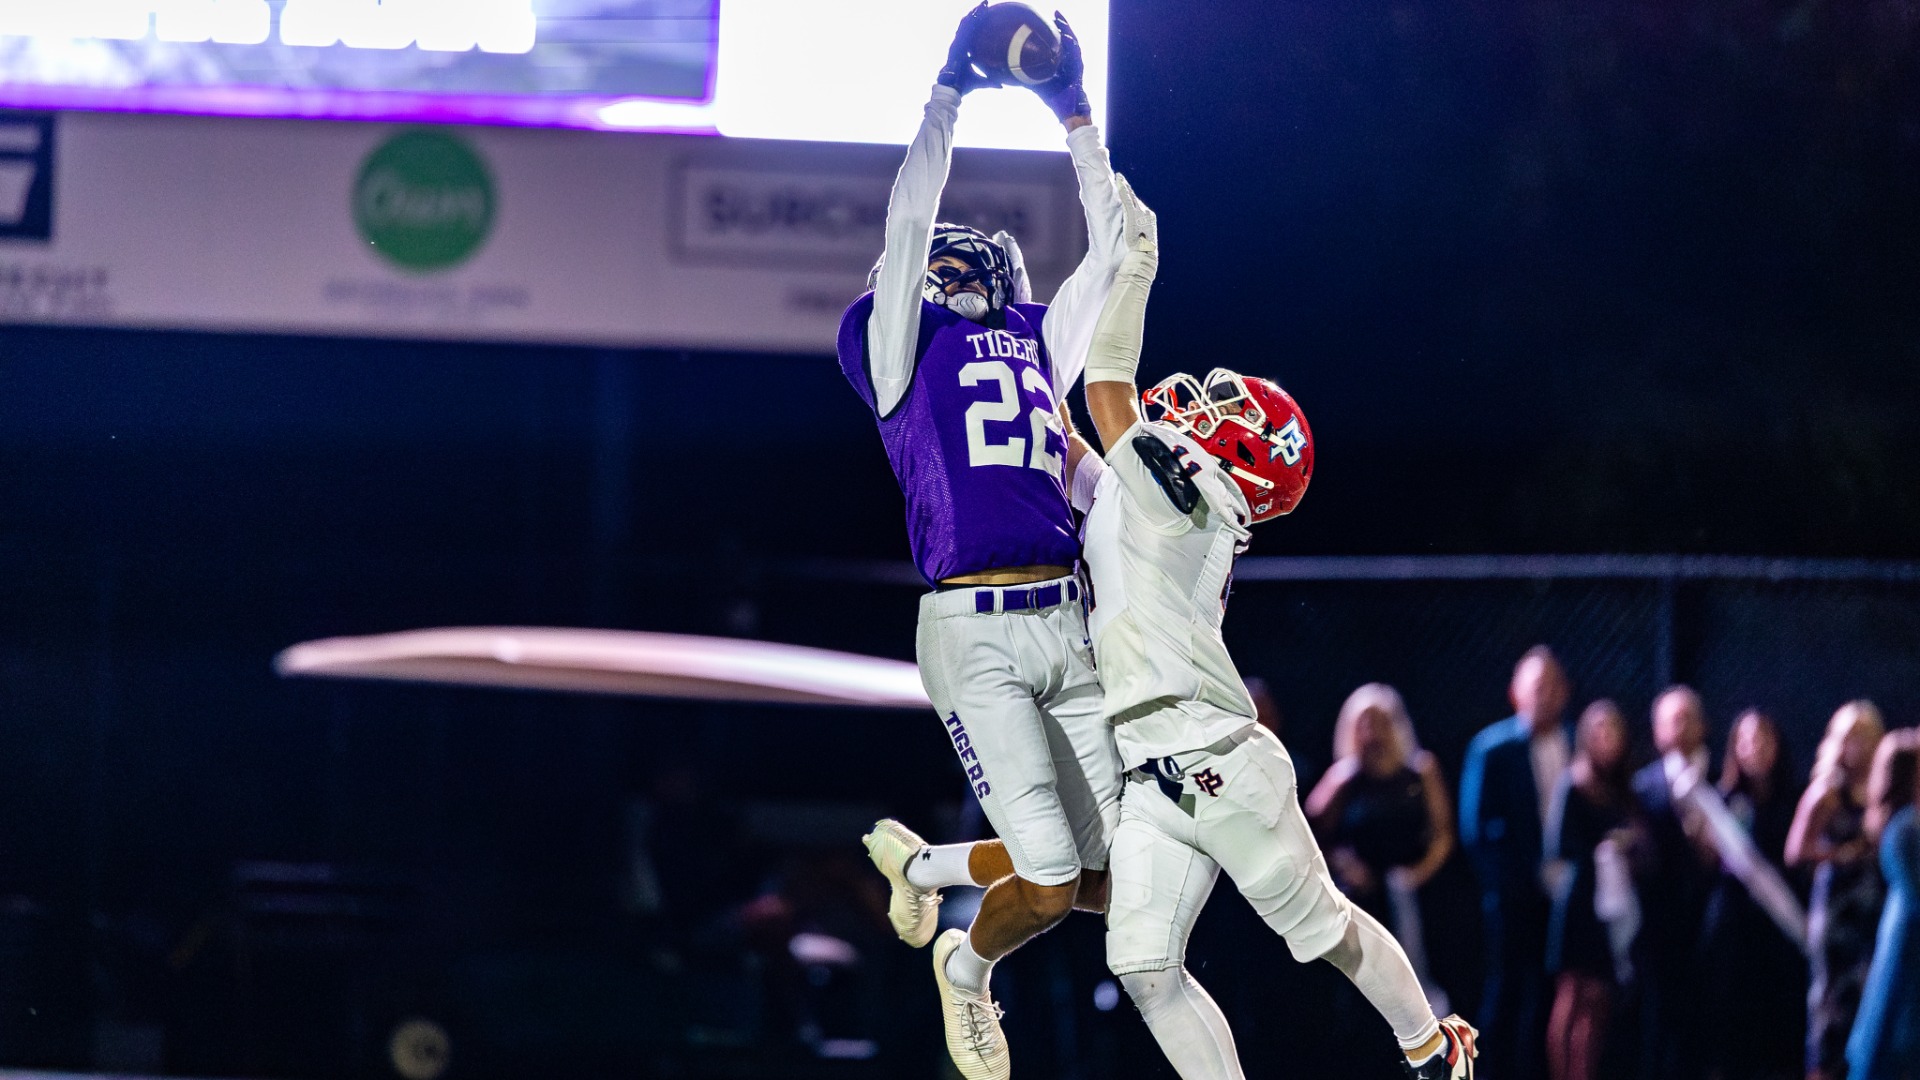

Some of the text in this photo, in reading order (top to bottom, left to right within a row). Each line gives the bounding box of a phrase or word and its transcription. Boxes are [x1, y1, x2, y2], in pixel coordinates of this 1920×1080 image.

[966, 330, 1039, 369] TIGERS
[958, 361, 1062, 482] 22
[945, 711, 991, 799] TIGERS
